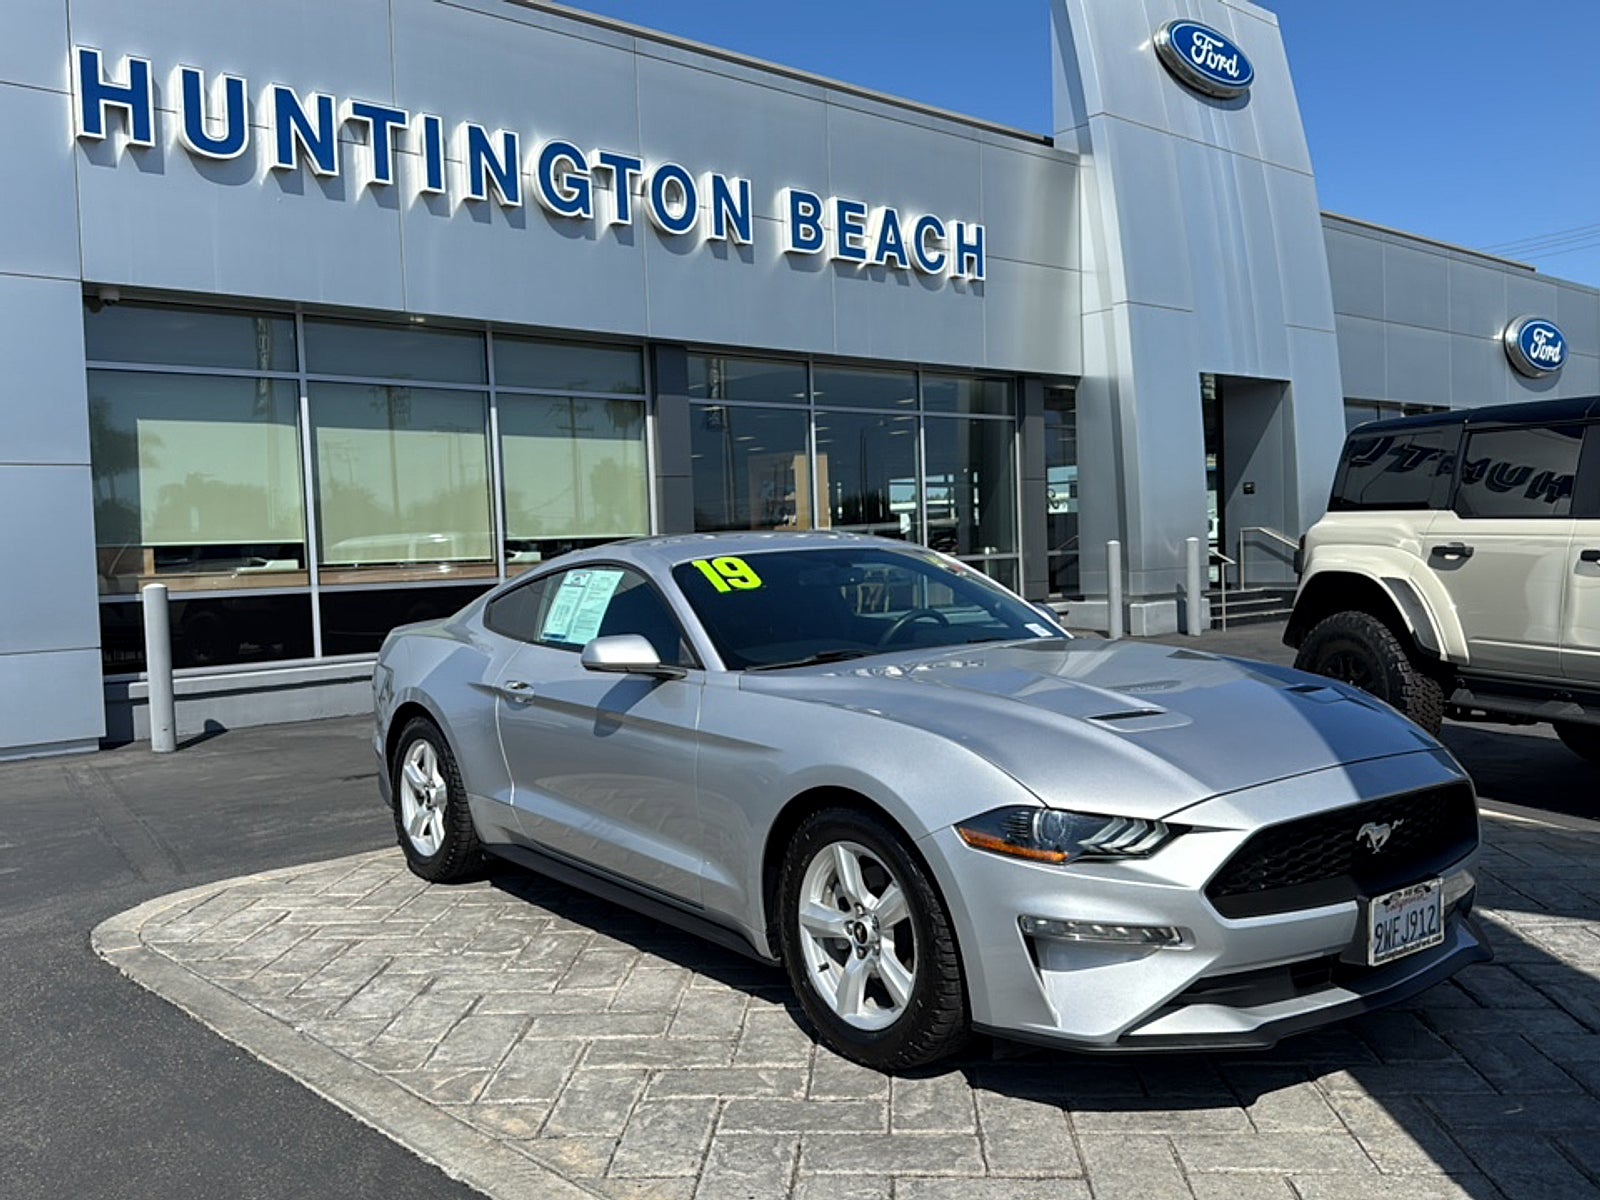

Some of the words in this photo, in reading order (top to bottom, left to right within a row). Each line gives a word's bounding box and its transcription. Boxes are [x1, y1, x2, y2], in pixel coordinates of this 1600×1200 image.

[1191, 31, 1240, 78] Ford
[76, 45, 754, 245] HUNTINGTON
[783, 187, 987, 281] BEACH
[1530, 327, 1562, 363] Ford
[692, 556, 763, 594] 19
